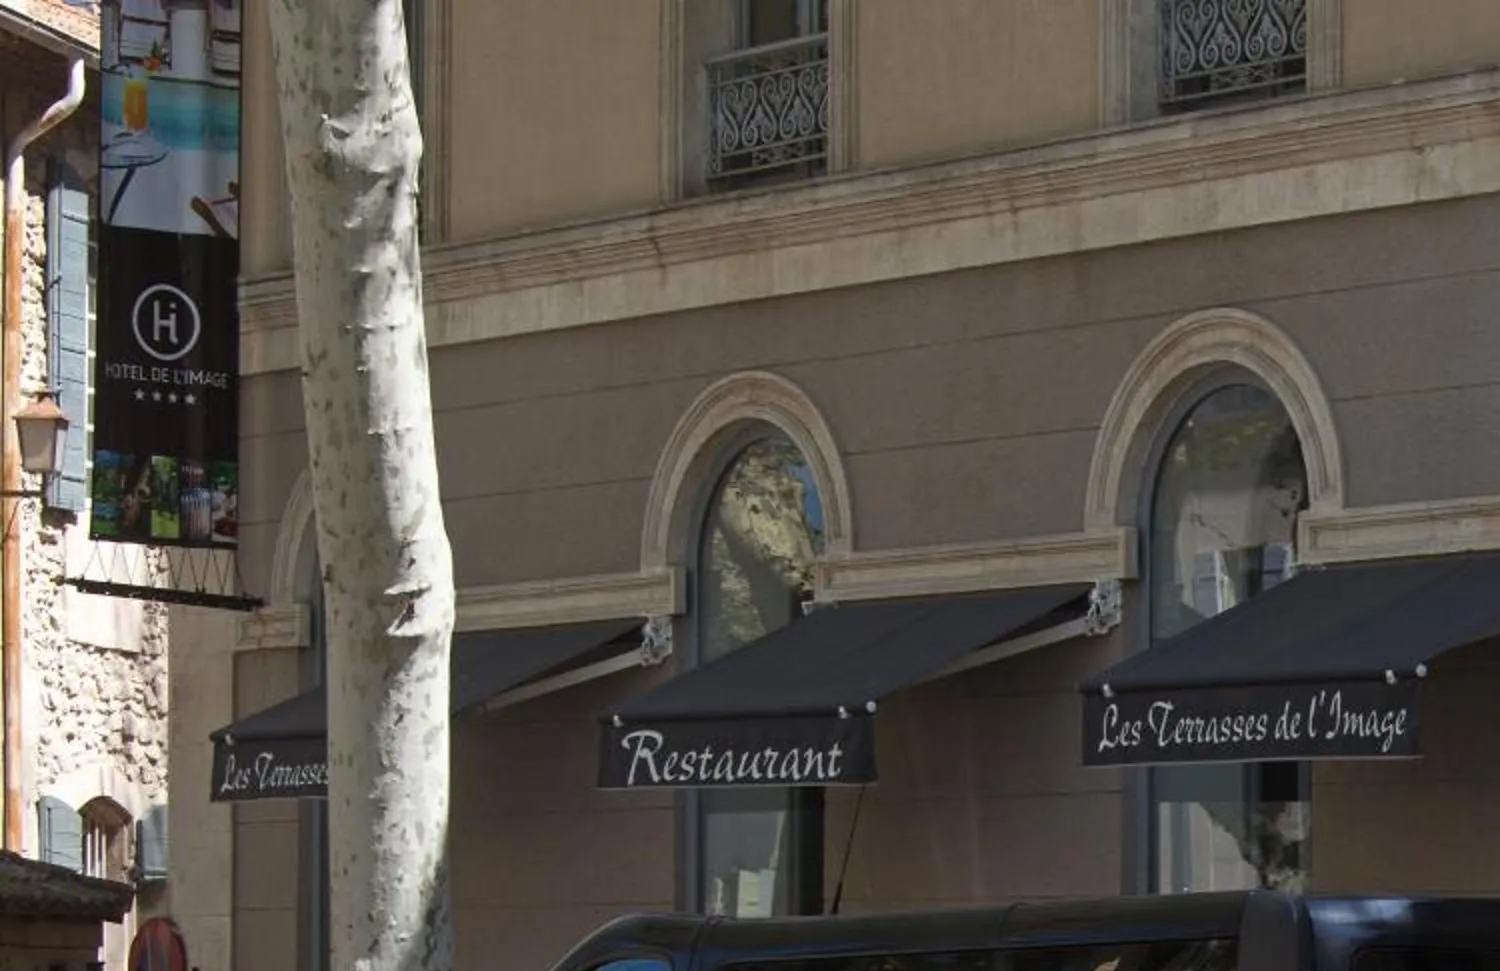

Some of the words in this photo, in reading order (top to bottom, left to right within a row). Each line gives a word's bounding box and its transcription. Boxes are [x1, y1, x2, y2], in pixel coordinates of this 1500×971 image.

[104, 361, 148, 381] HOTEL
[151, 366, 170, 383] DE
[1098, 703, 1142, 753] Les
[1148, 699, 1269, 748] Terrasses
[1274, 700, 1302, 741] de
[1308, 689, 1407, 753] l'Image
[221, 753, 251, 793] Les
[621, 729, 843, 785] Restaurant
